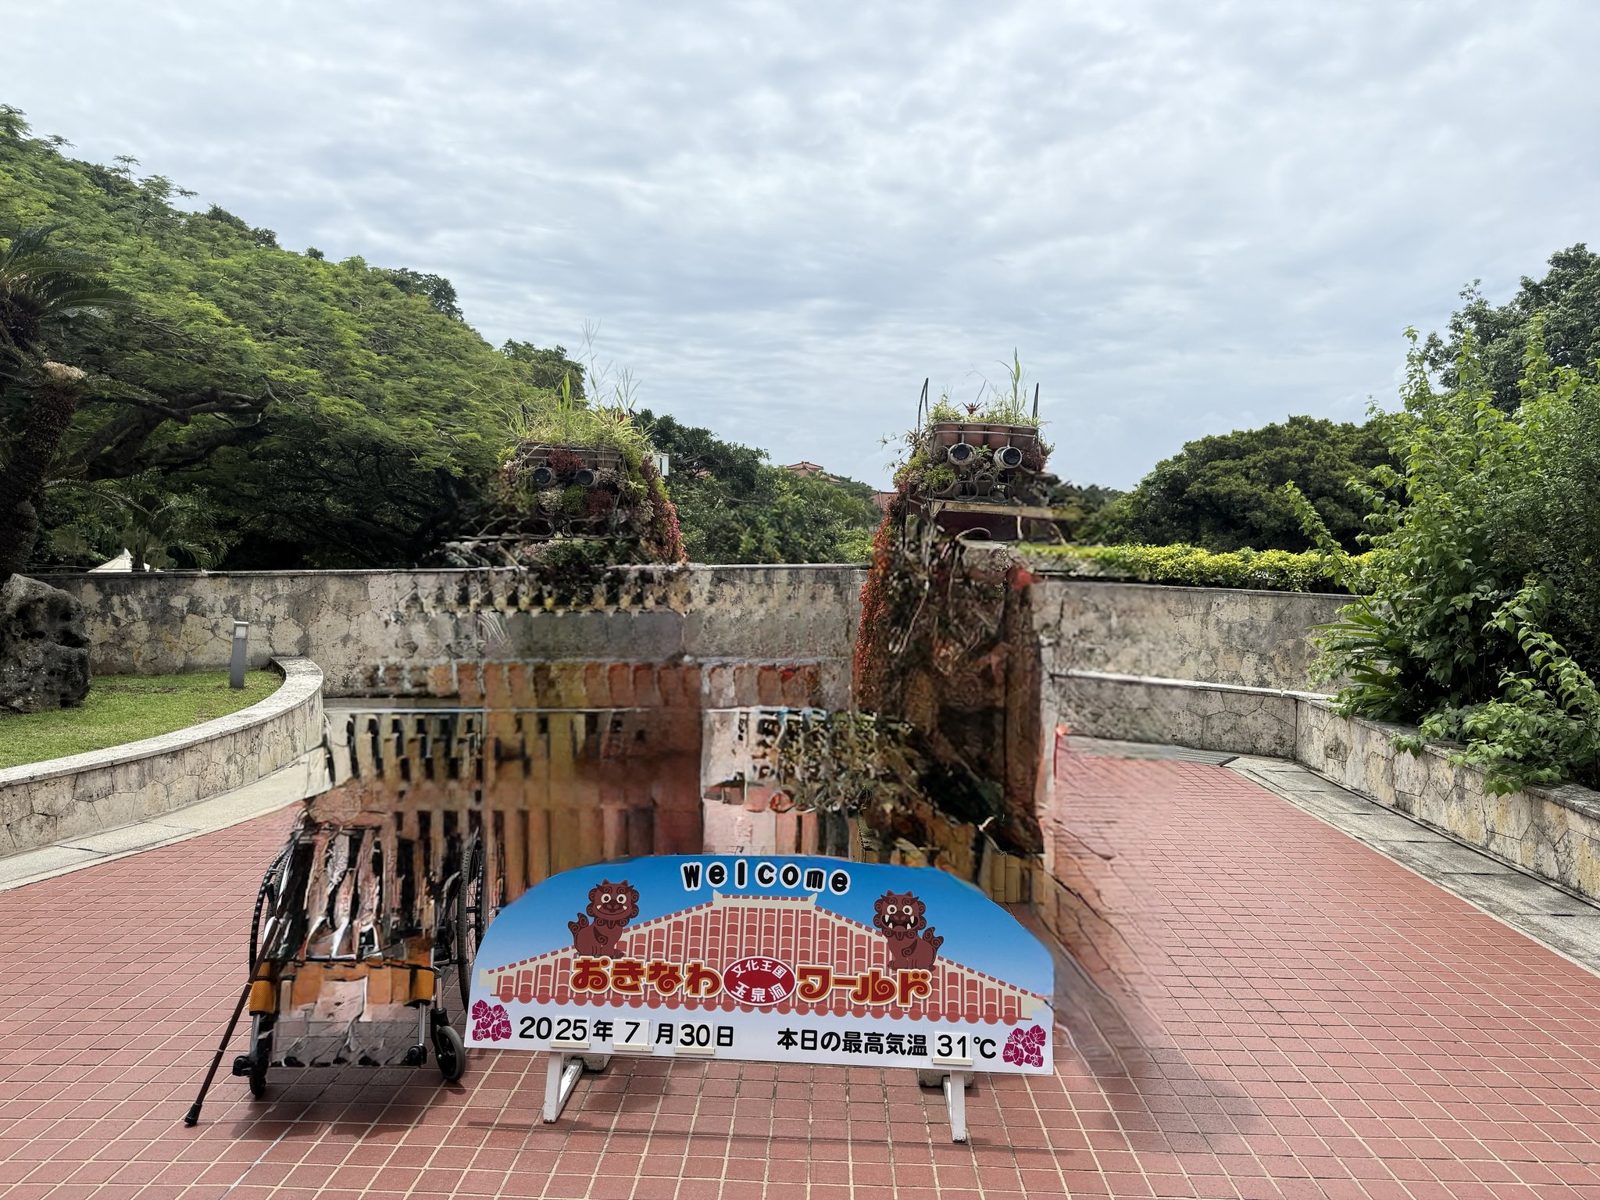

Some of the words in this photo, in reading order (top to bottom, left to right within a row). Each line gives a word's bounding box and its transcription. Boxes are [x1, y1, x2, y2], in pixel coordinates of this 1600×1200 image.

[680, 859, 851, 896] welcome
[570, 956, 724, 998] おきなわ
[796, 965, 933, 1007] ワールド
[731, 981, 788, 1003] 玉泉洞
